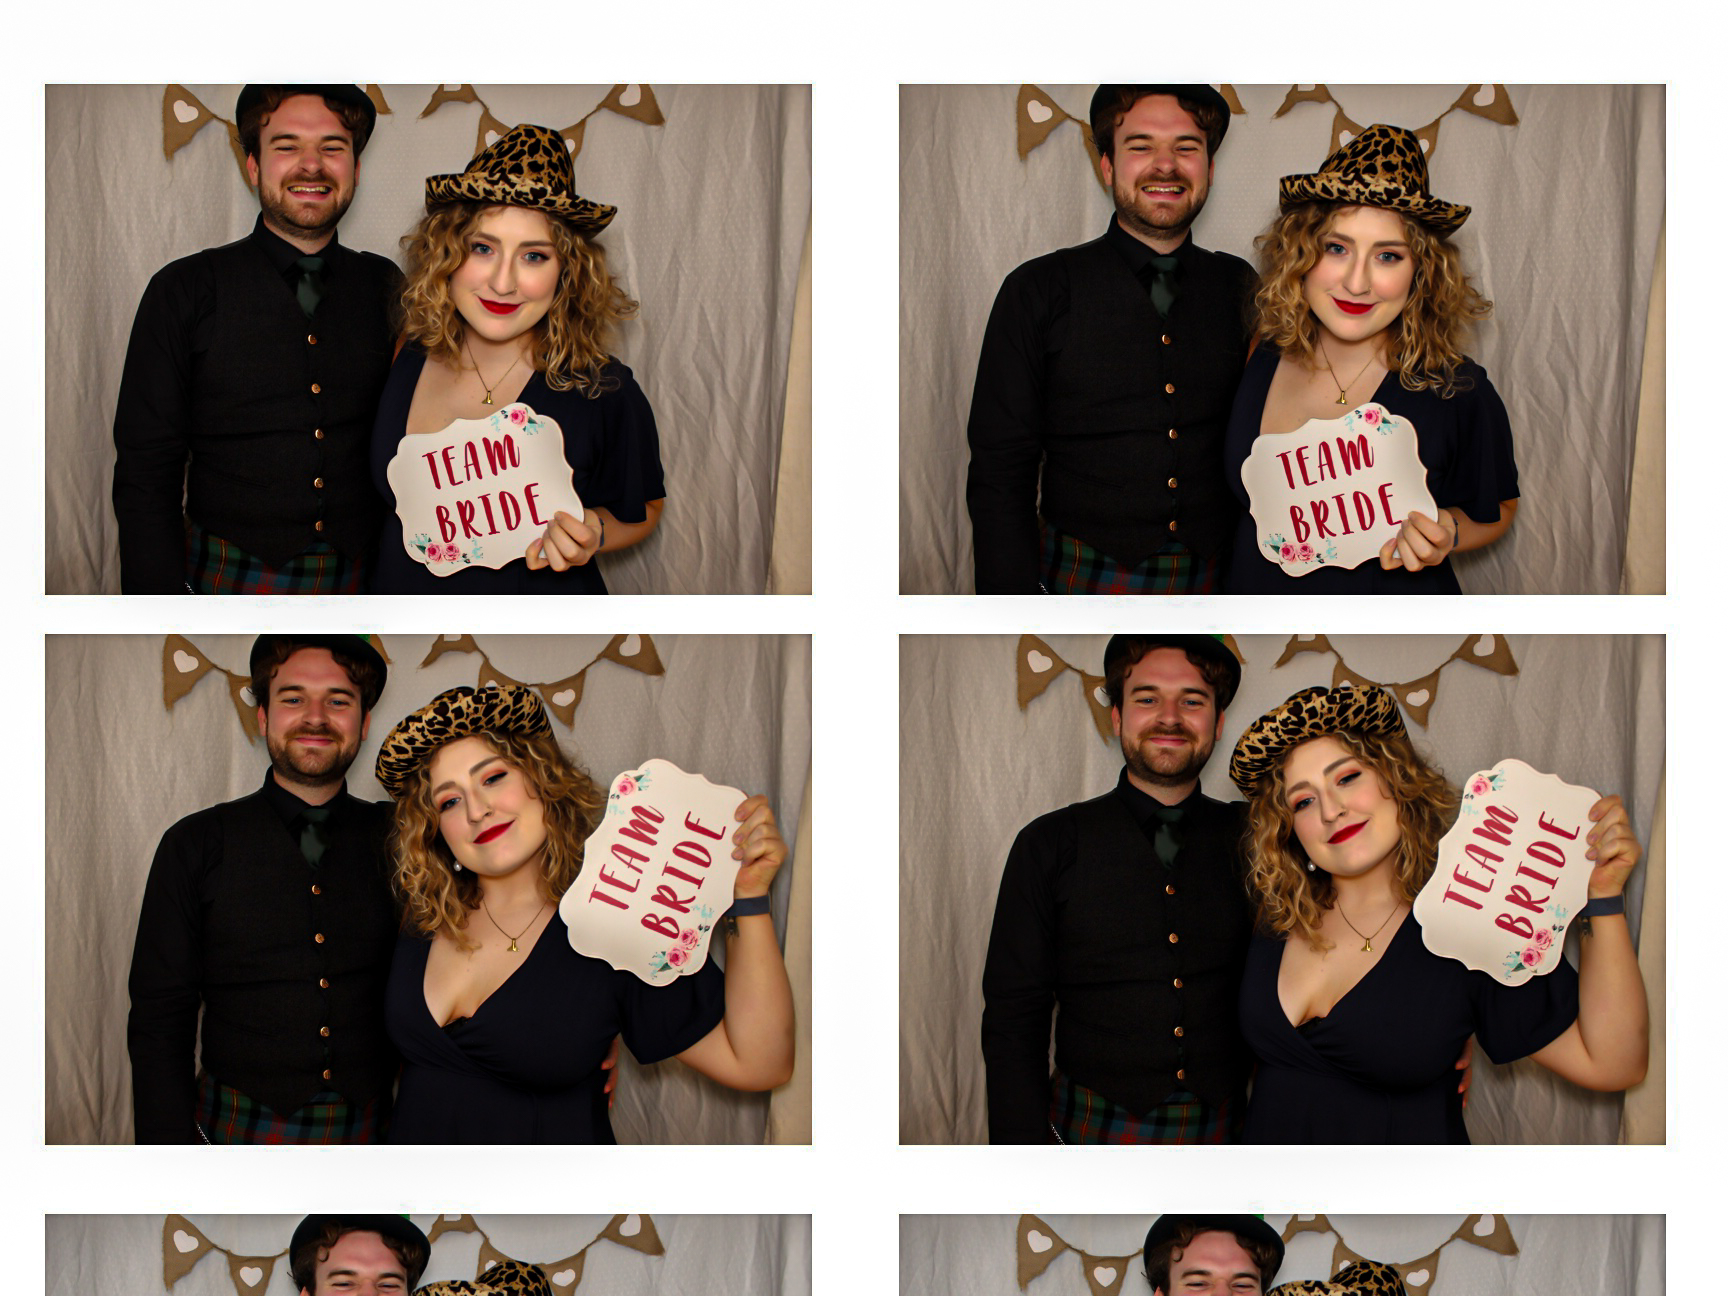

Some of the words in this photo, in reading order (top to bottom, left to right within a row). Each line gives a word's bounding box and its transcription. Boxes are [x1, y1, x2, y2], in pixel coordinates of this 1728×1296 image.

[422, 433, 521, 489] TEAM
[1276, 433, 1375, 489] TEAM
[435, 483, 549, 543] BRIDE
[1289, 483, 1403, 543] BRIDE
[589, 804, 665, 911] TEAM
[641, 810, 726, 939] BRIDE
[1443, 804, 1519, 911] TEAM
[1495, 810, 1580, 939] BRIDE
